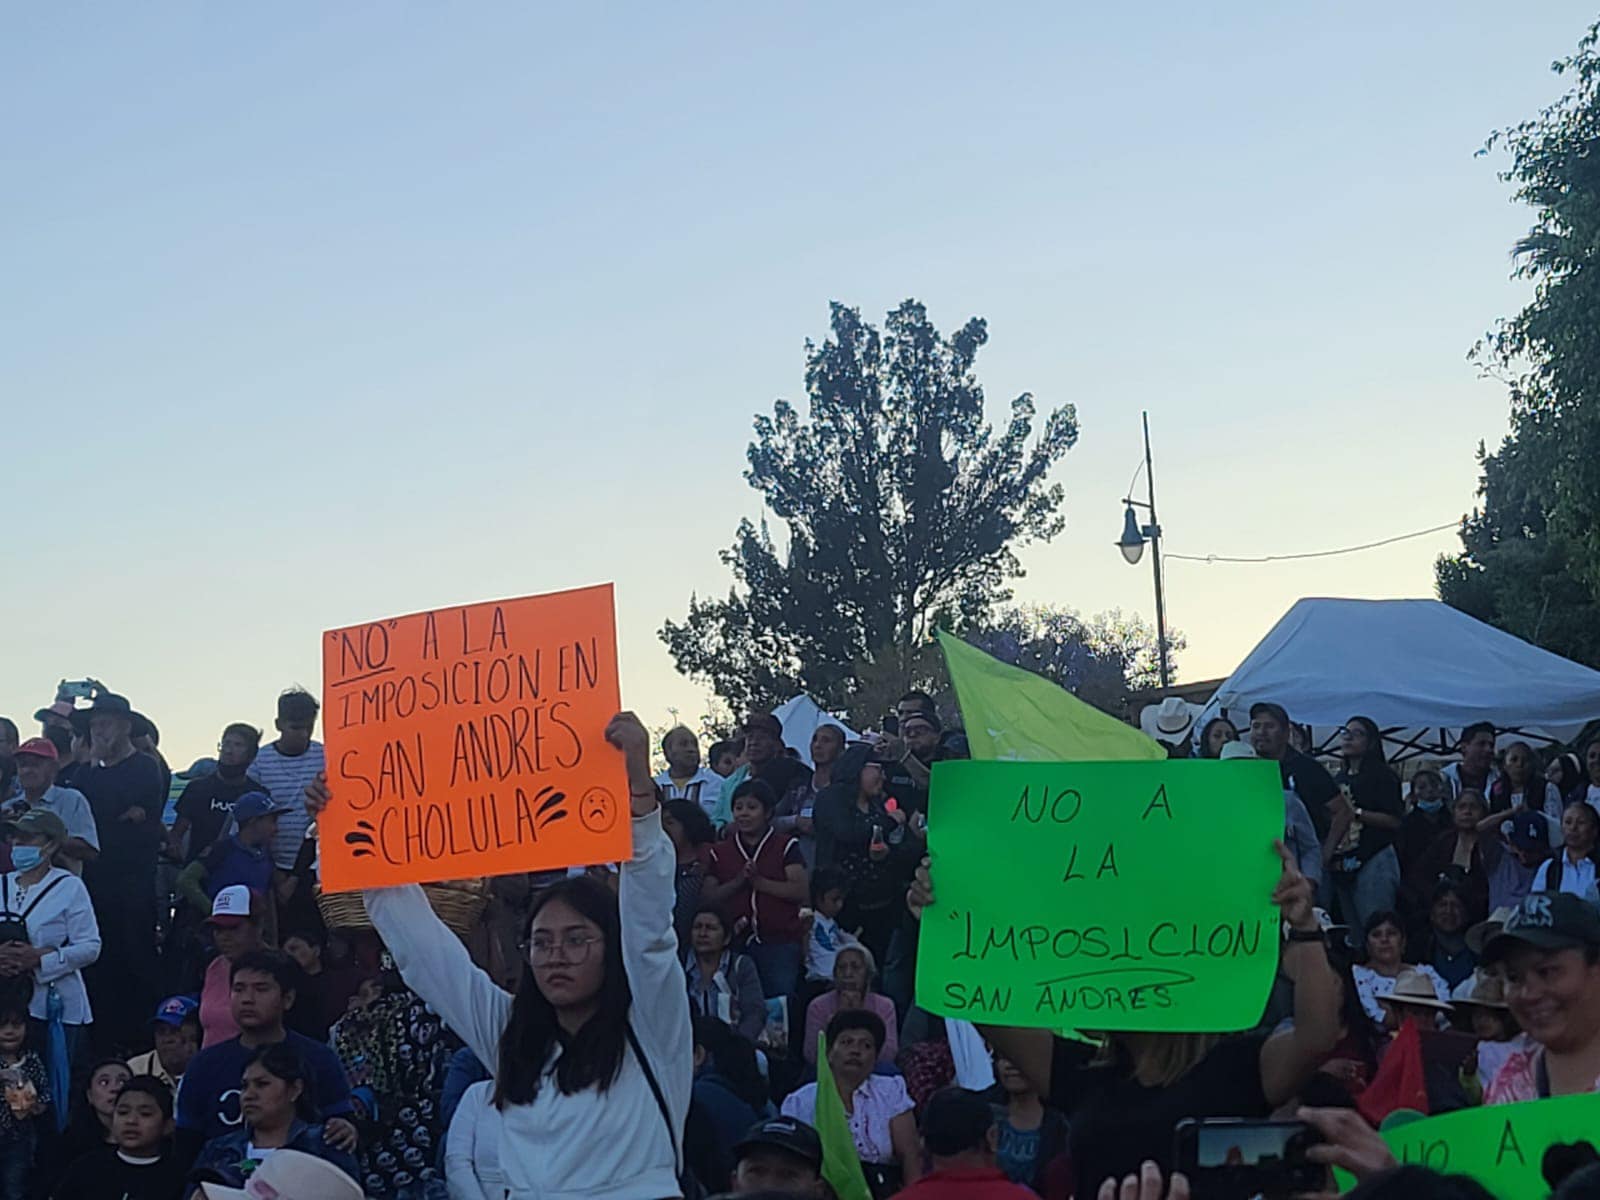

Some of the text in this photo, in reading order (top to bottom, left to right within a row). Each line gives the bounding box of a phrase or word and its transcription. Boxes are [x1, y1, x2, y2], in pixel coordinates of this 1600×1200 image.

[423, 612, 439, 659] A
[462, 607, 508, 655] LA
[338, 638, 597, 730] IMPOSICIÓN EN
[341, 698, 582, 811] SAN ANDRÉS
[380, 788, 537, 865] CHOLULA
[1012, 784, 1172, 823] NO A
[1063, 843, 1118, 882] LA
[944, 982, 1011, 1011] SAN
[1496, 1119, 1526, 1166] A
